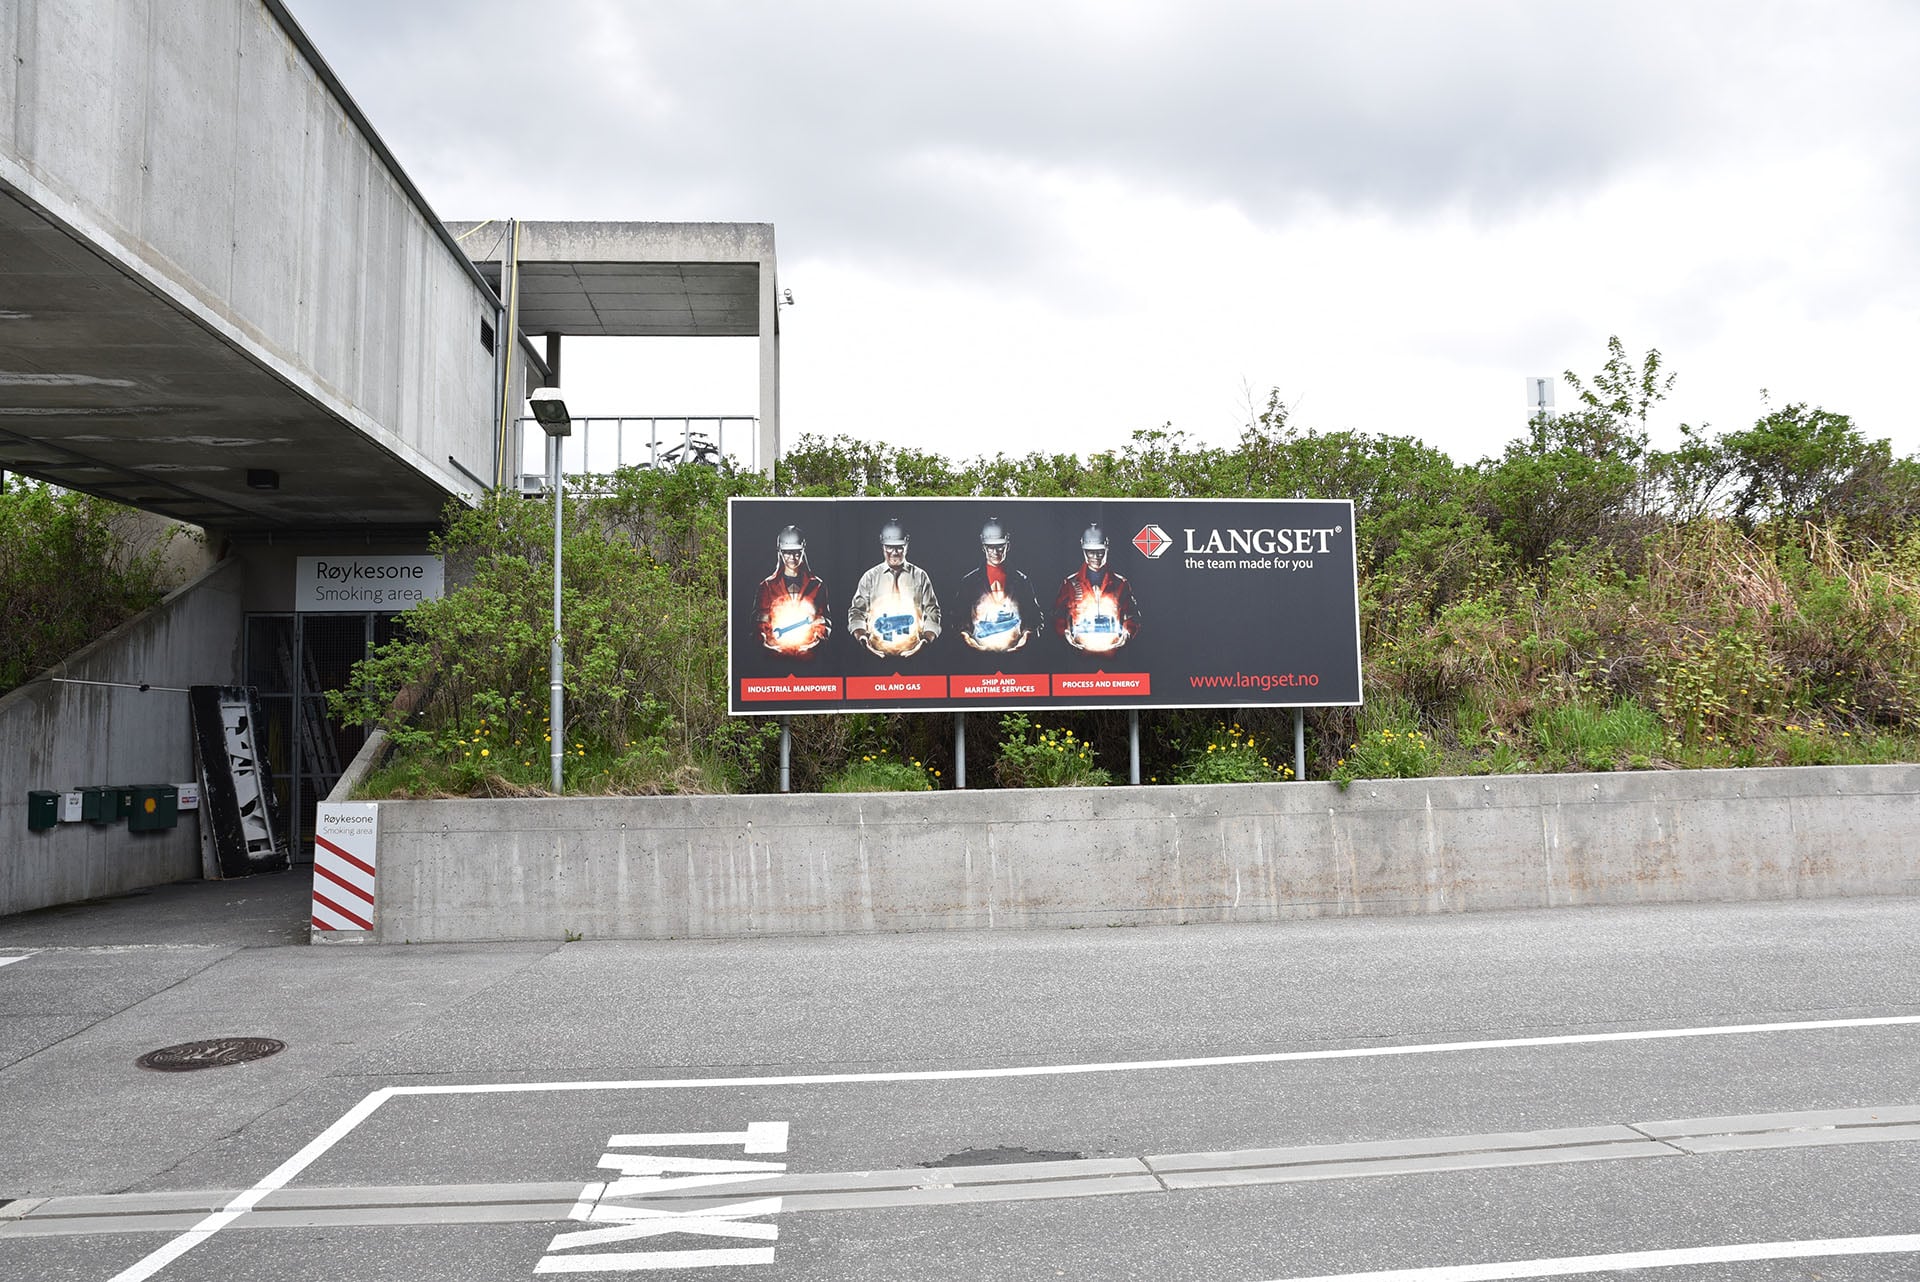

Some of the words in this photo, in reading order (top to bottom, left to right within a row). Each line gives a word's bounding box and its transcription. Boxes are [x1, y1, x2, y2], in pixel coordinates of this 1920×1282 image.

[1185, 557, 1204, 569] the
[1207, 558, 1236, 569] team
[1239, 557, 1271, 569] made
[1274, 557, 1290, 569] for
[1292, 559, 1314, 571] you
[316, 561, 424, 583] Røykesone
[315, 586, 384, 604] Smoking
[387, 589, 423, 601] area
[1095, 680, 1111, 688] AND
[1112, 680, 1140, 688] ENERGY
[1189, 671, 1319, 691] www.langset.no
[747, 685, 792, 693] INDUSTRIAL
[793, 684, 837, 692] MANPOWER
[887, 683, 904, 691] AND
[905, 683, 921, 691] GAS
[1001, 685, 1036, 693] SERVICES
[323, 813, 374, 825] Røykesone
[323, 826, 355, 836] Smoking
